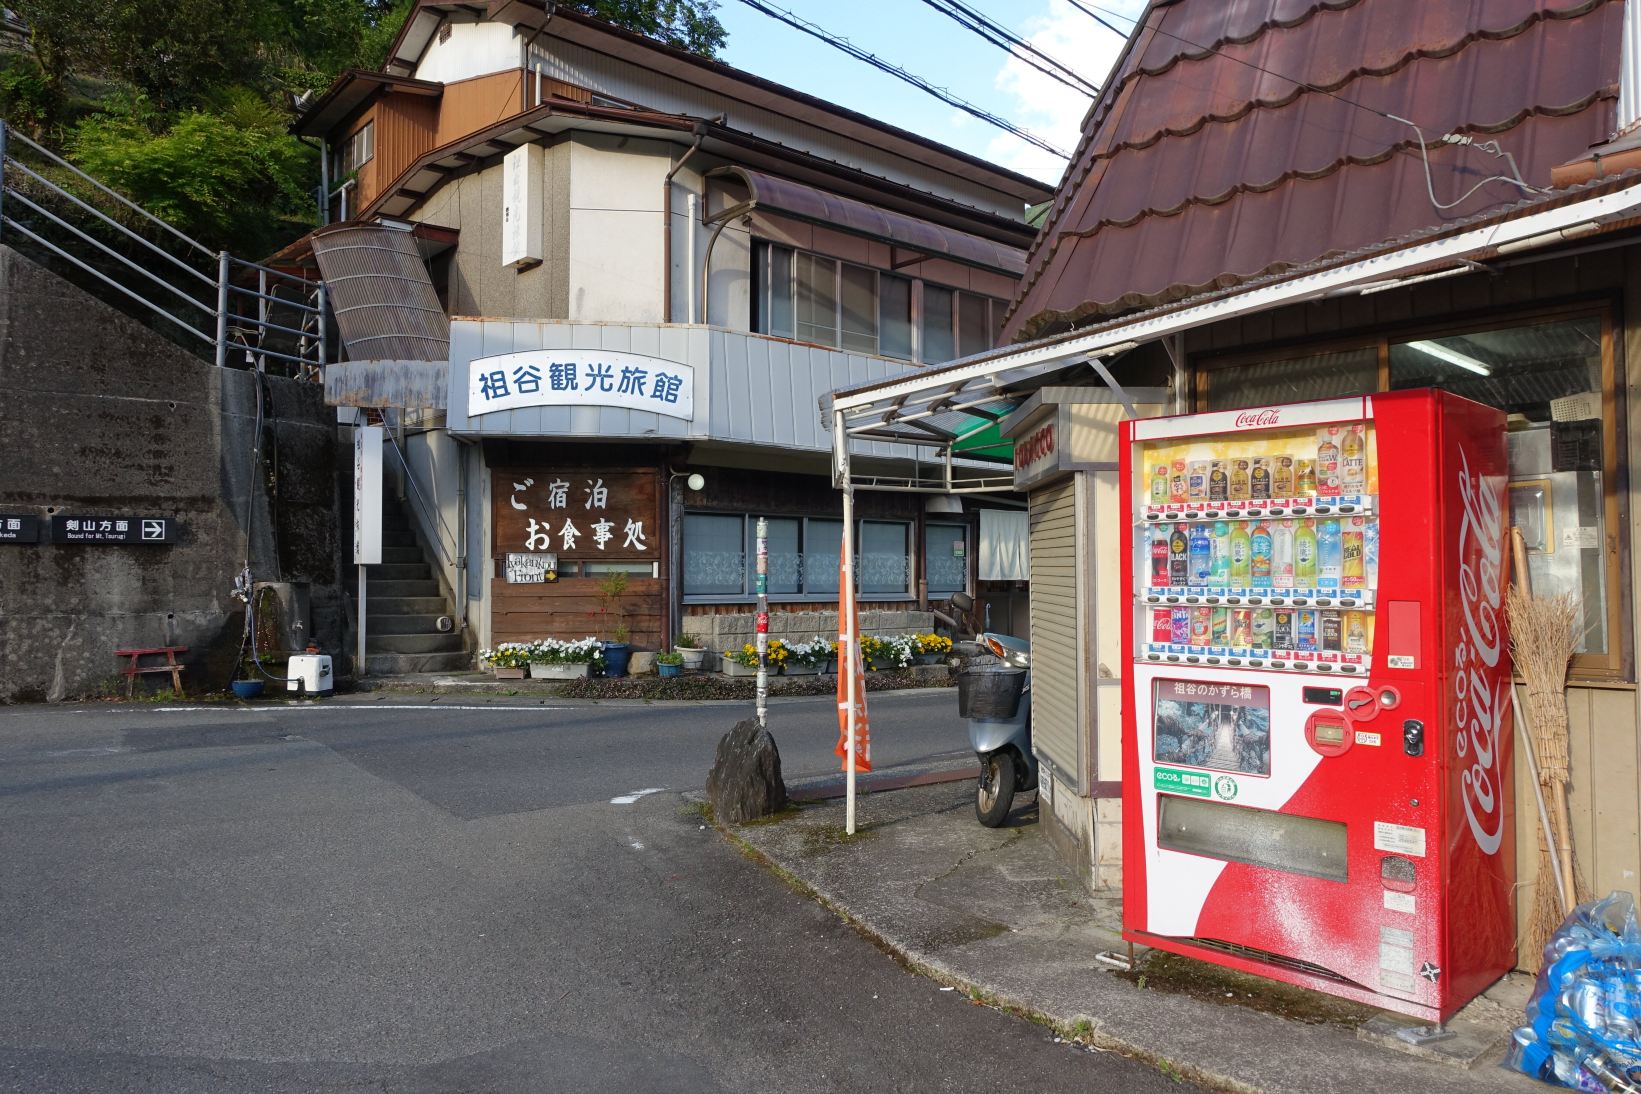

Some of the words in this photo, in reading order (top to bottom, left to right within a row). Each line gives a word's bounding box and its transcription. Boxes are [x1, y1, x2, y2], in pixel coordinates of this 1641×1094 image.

[478, 362, 683, 404] 祖谷観光旅館
[1235, 409, 1280, 428] Coca-Cola
[510, 477, 609, 510] ご宿泊
[66, 519, 129, 531] 剣山方面
[105, 532, 126, 540] Tsurugi
[524, 517, 648, 551] お食事処
[1458, 441, 1504, 856] Coca-Cola
[1174, 682, 1253, 700] 祖谷のかずら橋
